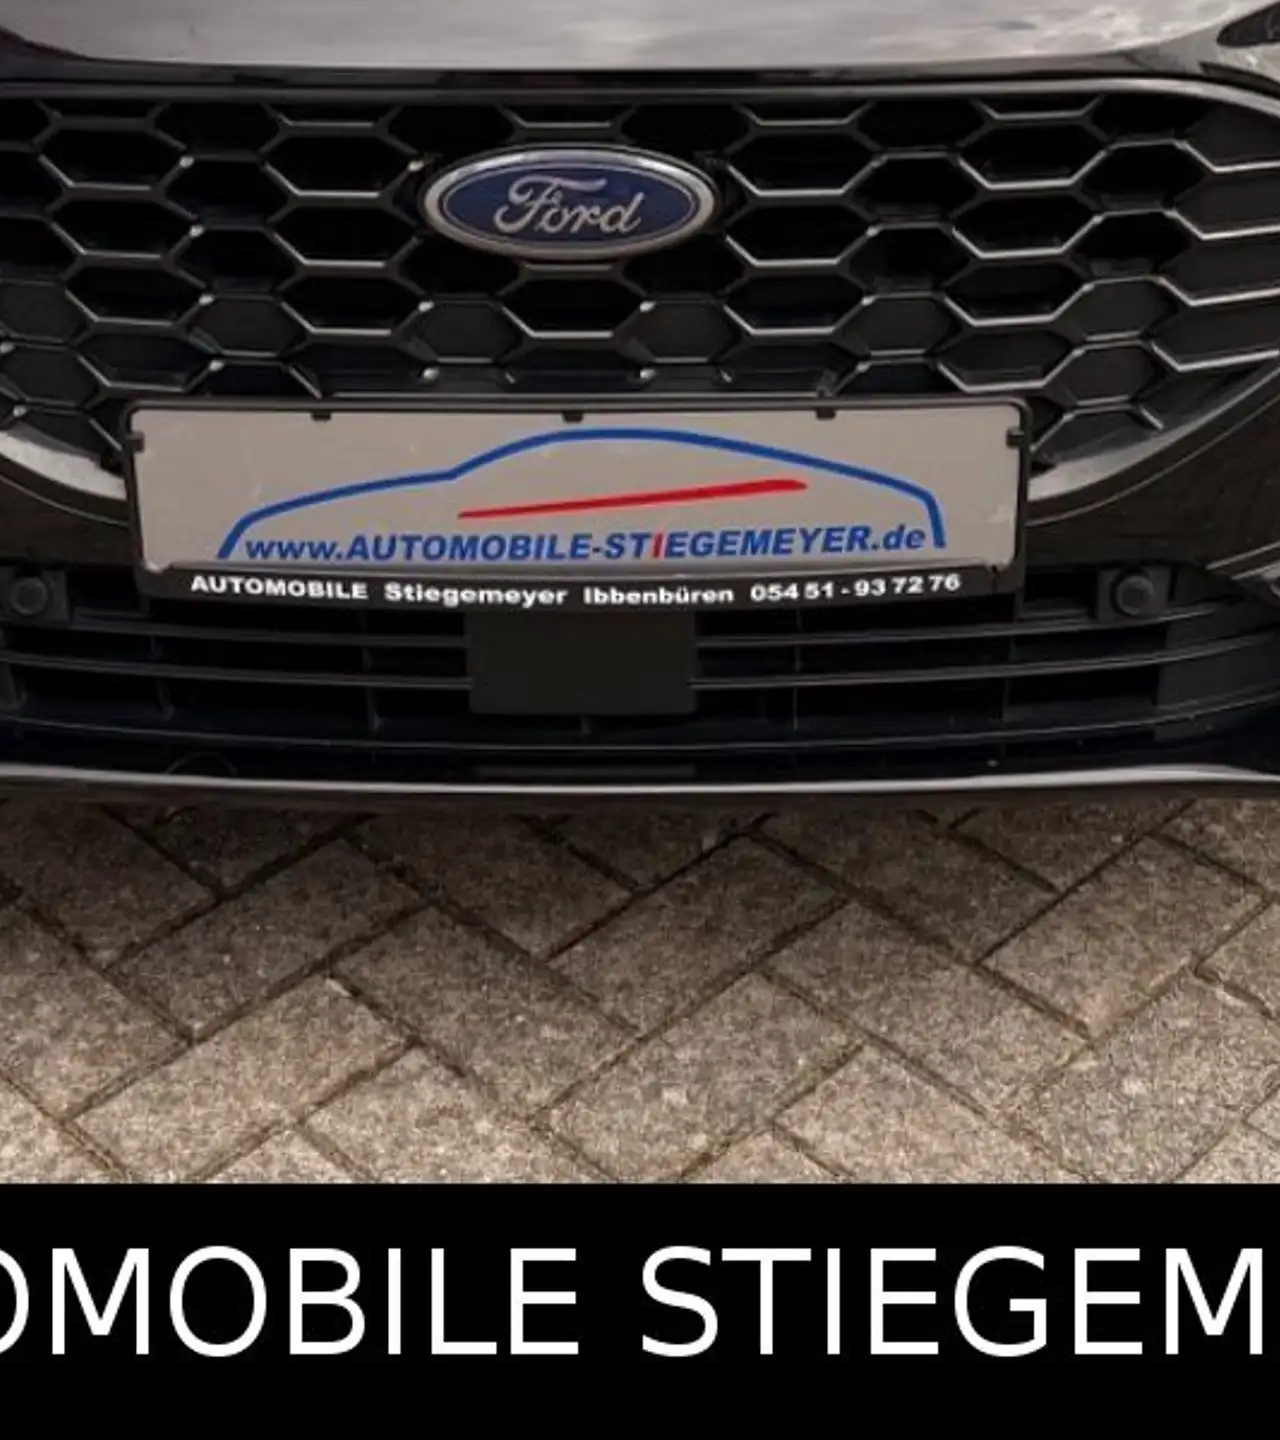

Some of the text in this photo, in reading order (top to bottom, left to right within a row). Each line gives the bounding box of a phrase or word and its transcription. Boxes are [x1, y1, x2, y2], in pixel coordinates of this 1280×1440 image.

[493, 175, 645, 234] Ford
[245, 524, 926, 561] www.AUTOMOBILE-STIEGEMEYER.de
[190, 575, 369, 600] AUTOMOBILE
[384, 582, 568, 608] Stiegemeyer
[584, 584, 734, 604] Ibbenbüren
